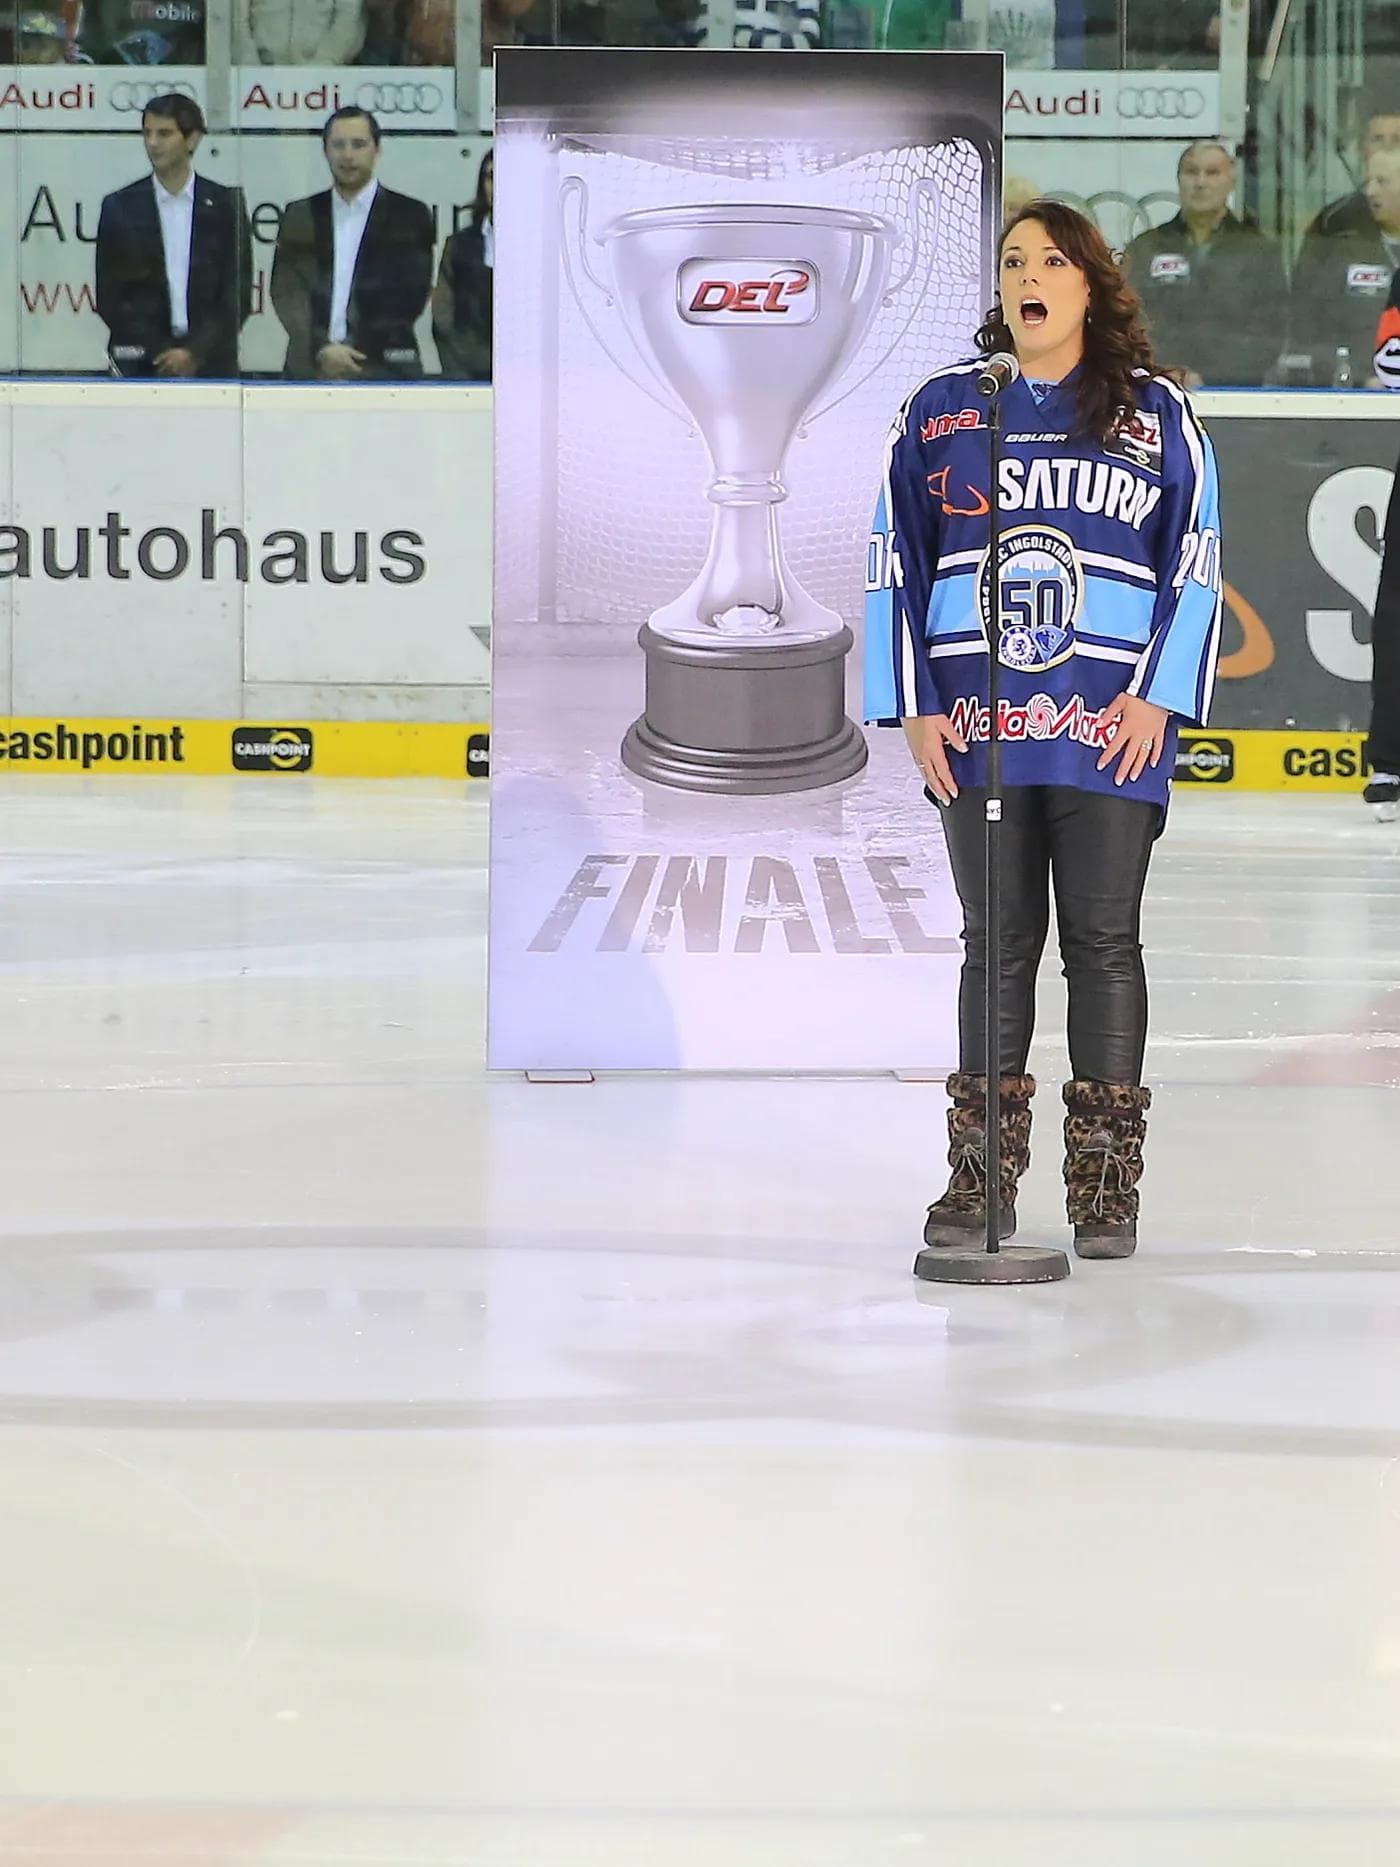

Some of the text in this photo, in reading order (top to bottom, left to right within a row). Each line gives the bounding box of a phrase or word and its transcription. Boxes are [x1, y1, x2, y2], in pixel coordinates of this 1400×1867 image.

[1, 84, 95, 109] Audi
[243, 84, 341, 110] Audi
[1006, 90, 1100, 115] Audi
[1004, 434, 1068, 443] BAUER
[998, 458, 1161, 530] SATURN
[0, 508, 426, 584] autohaus
[1000, 580, 1064, 630] 50
[234, 742, 311, 756] CASHPOINT
[527, 854, 960, 954] FINALE
